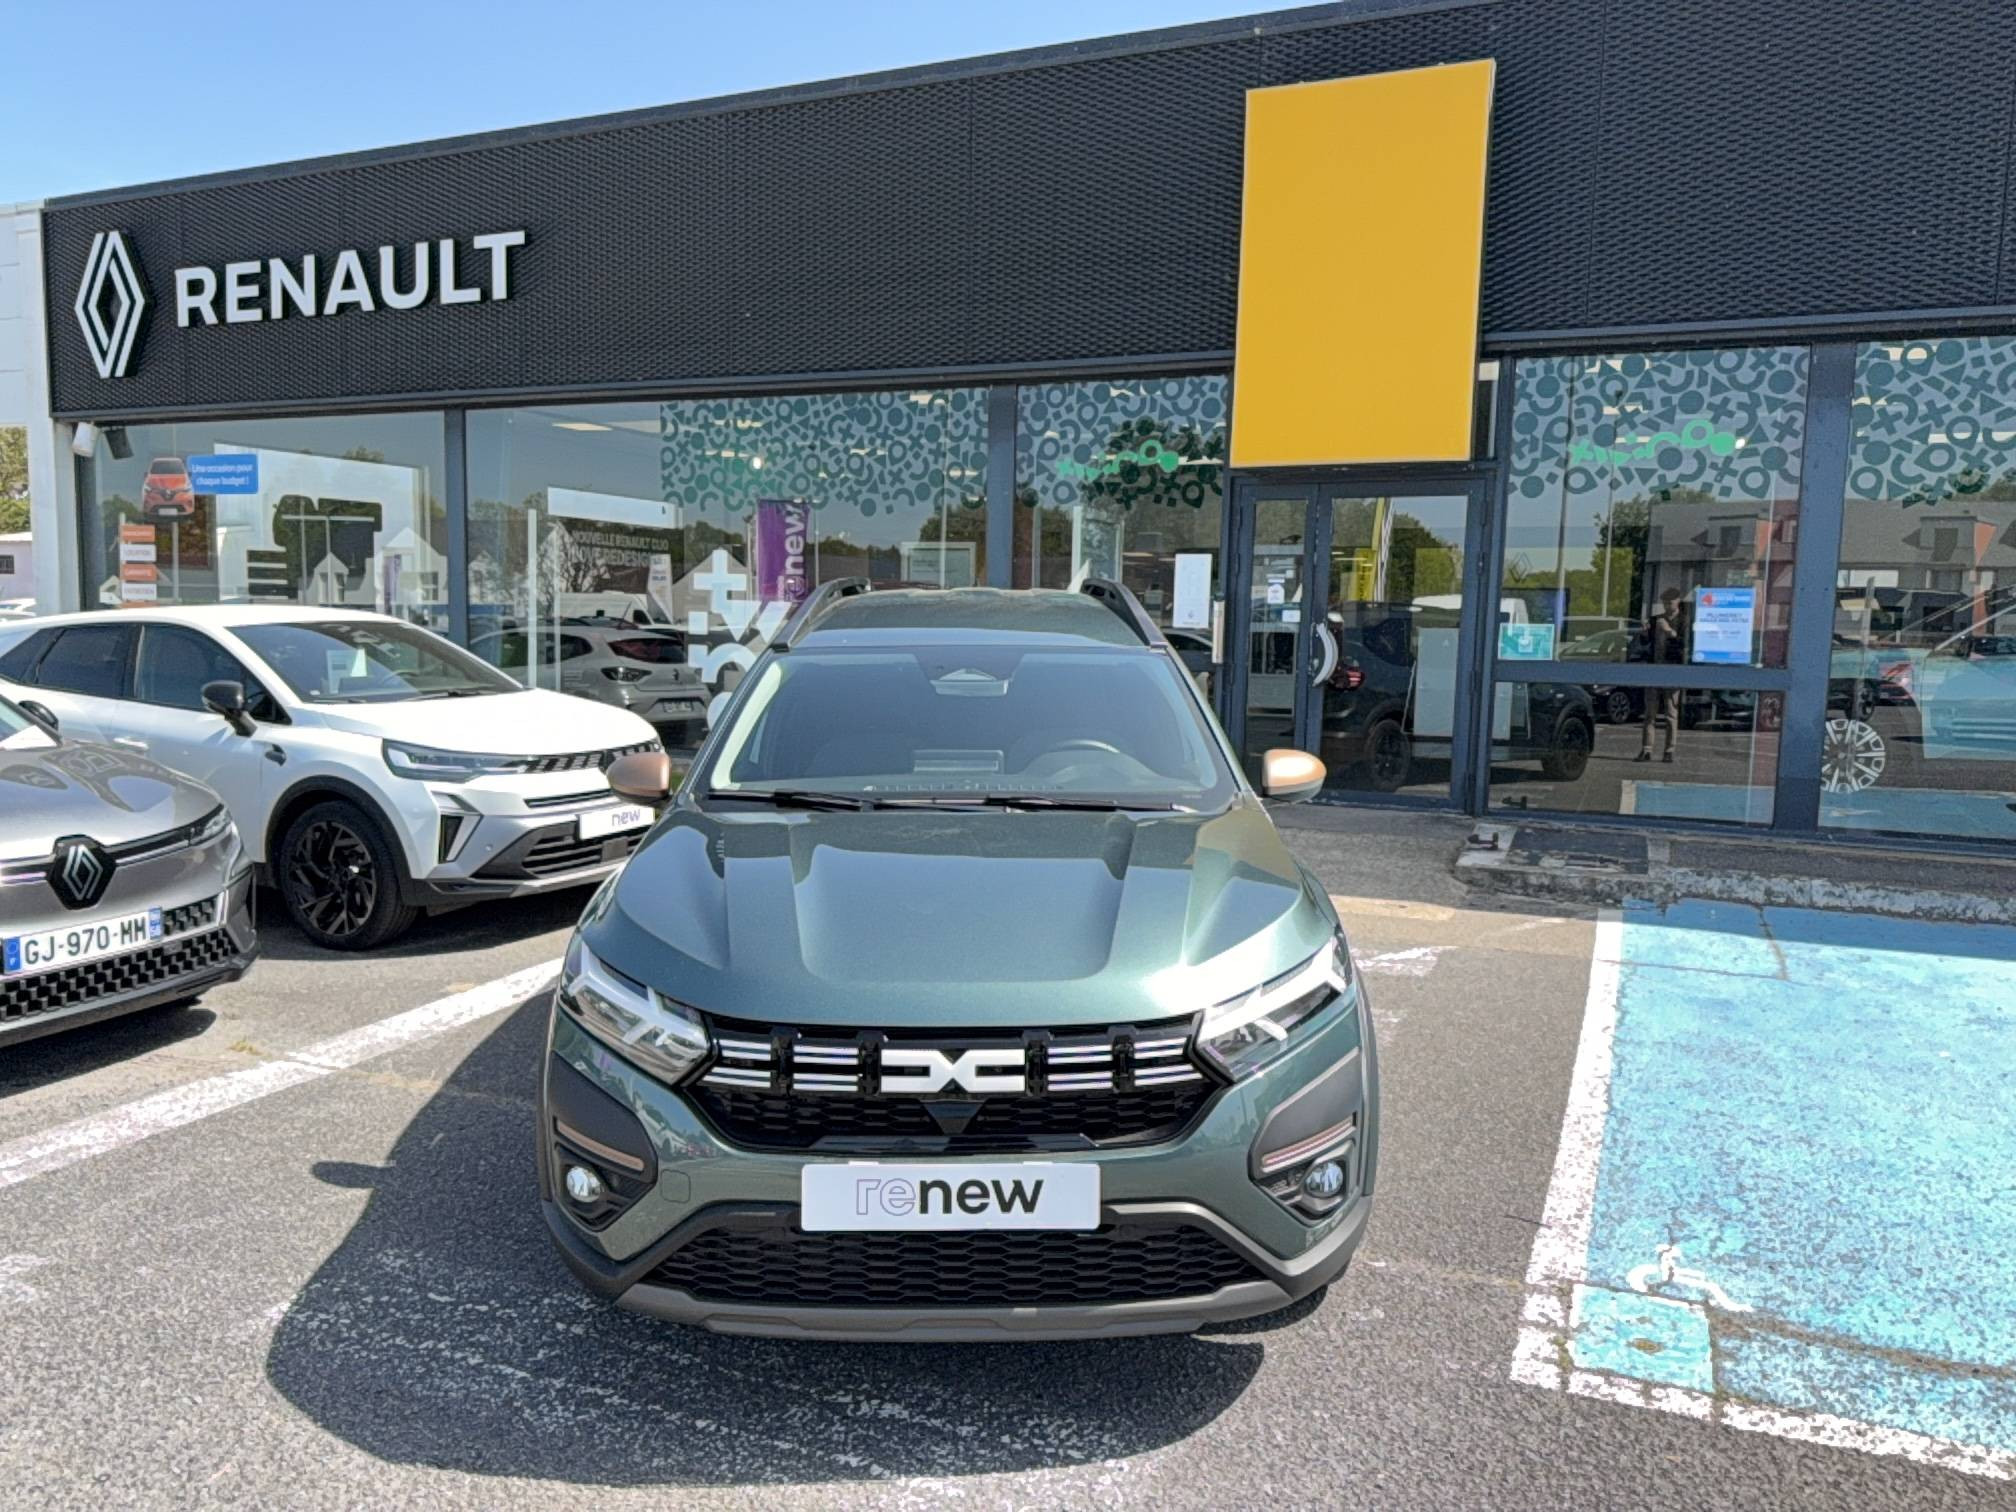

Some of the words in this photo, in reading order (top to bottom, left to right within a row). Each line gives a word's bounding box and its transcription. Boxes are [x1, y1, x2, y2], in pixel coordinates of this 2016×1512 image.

[175, 231, 525, 327] RENAULT
[191, 464, 206, 473] Une
[207, 464, 235, 473] occasion
[236, 464, 253, 475] pour
[196, 476, 220, 487] chaque
[221, 476, 246, 487] budget
[615, 533, 650, 549] RENAULT
[651, 538, 669, 551] CLIO
[25, 916, 146, 965] GJ-970-MM
[856, 1178, 1044, 1216] renew
